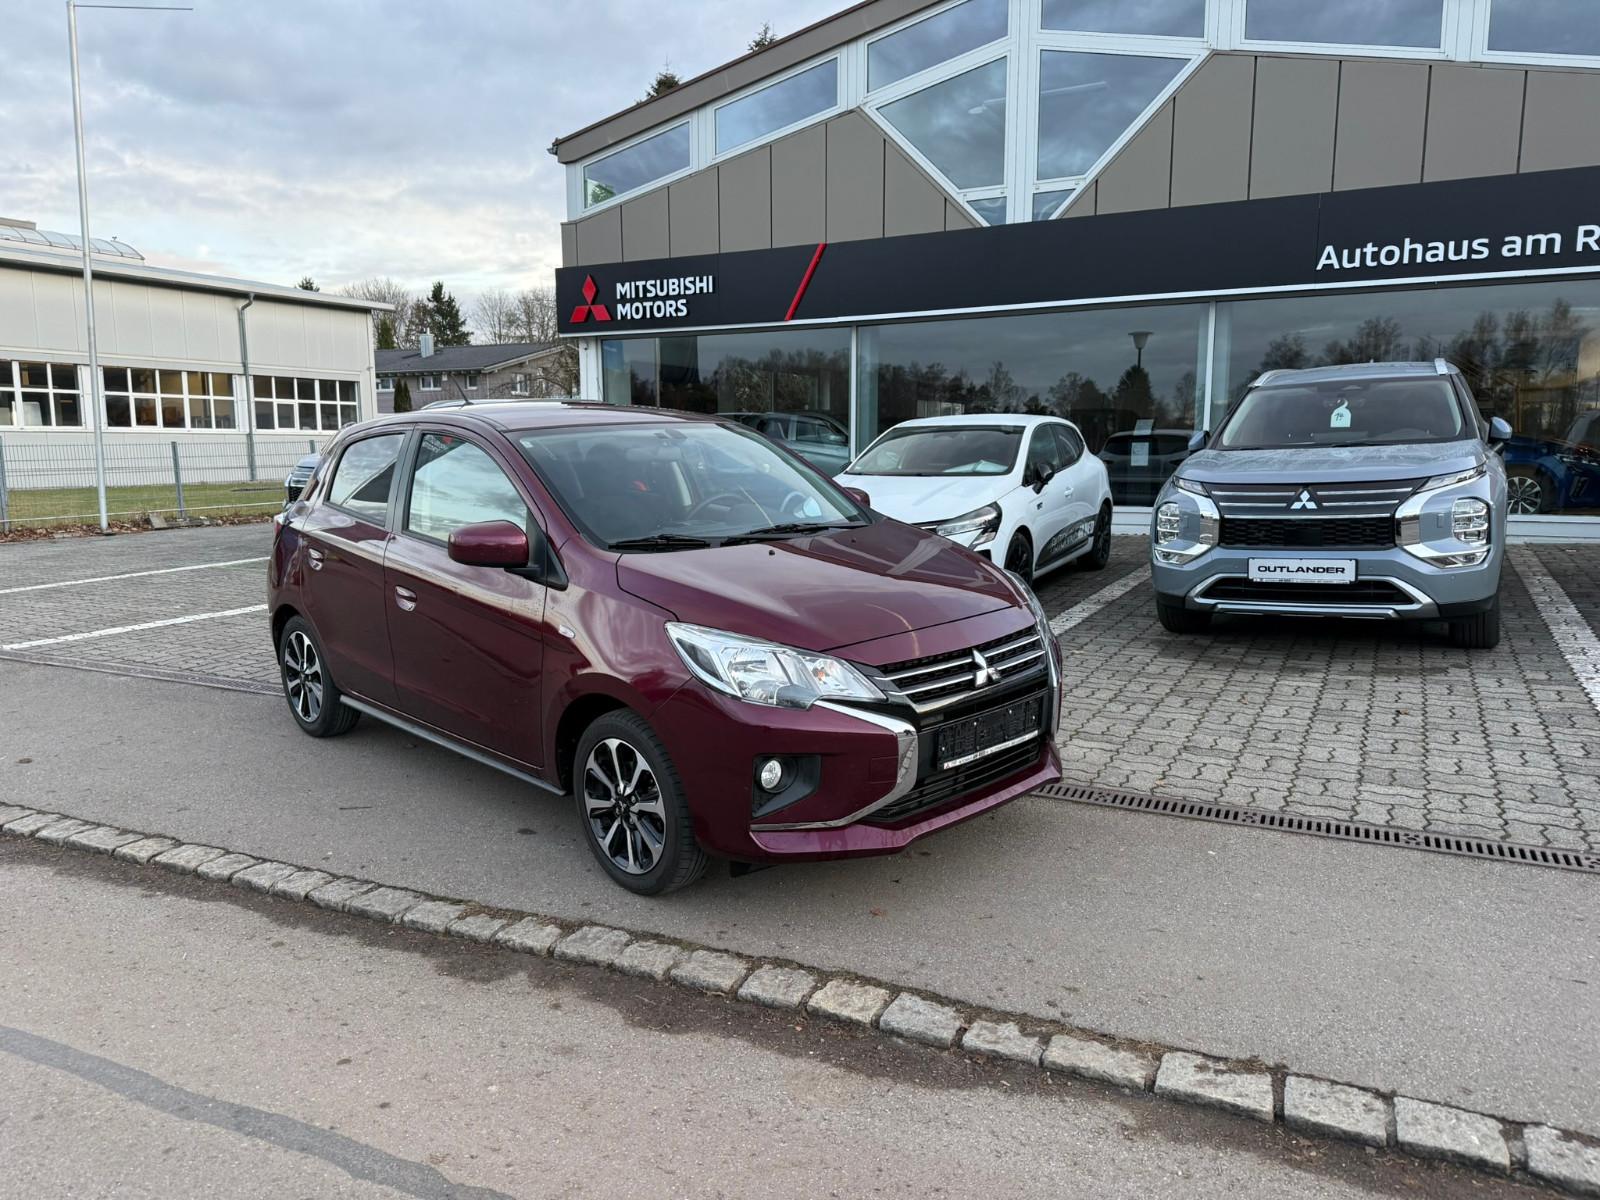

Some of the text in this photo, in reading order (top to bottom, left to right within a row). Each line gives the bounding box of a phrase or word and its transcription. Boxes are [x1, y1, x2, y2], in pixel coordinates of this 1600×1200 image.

[1315, 237, 1490, 271] Autohaus
[1501, 232, 1562, 258] am
[615, 275, 713, 300] MITSUBISHI
[616, 298, 688, 321] MOTORS
[1257, 565, 1346, 574] OUTLANDER
